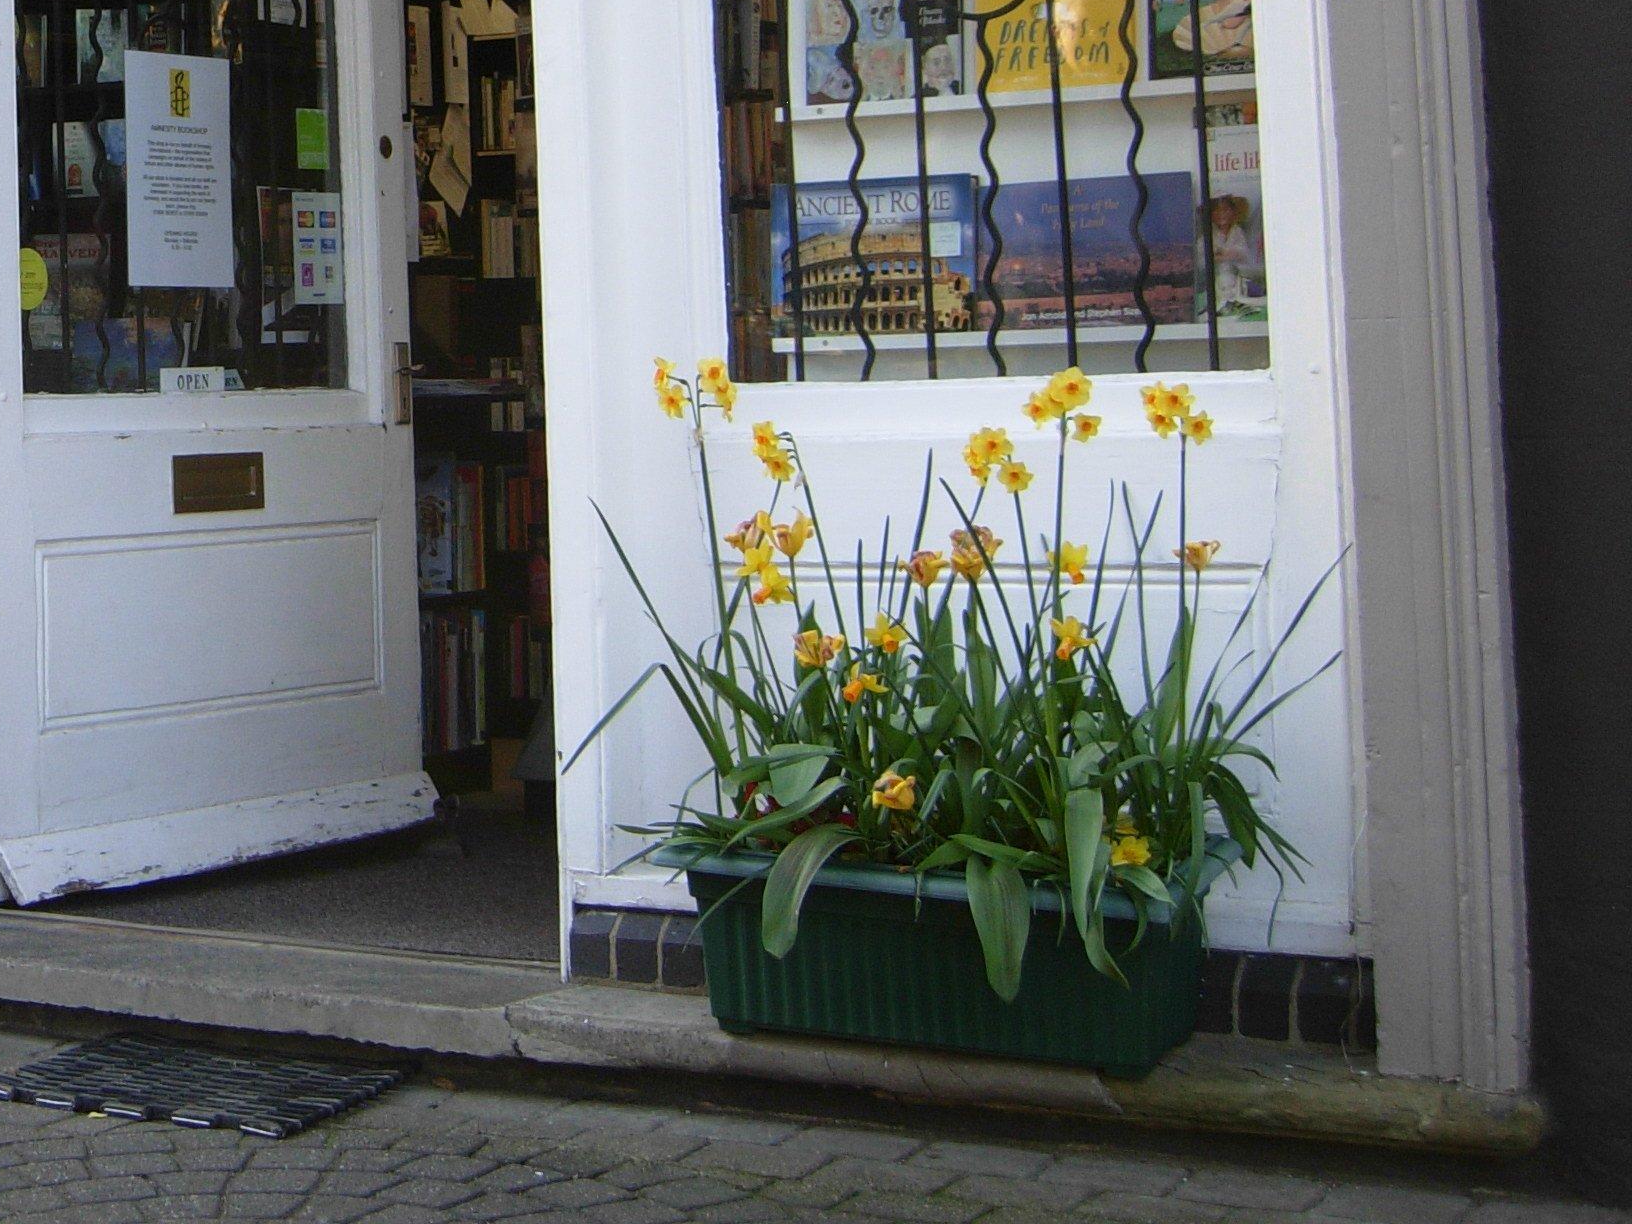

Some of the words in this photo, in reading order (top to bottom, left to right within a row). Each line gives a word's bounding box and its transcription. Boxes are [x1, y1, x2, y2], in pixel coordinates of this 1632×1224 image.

[999, 17, 1089, 45] DRES
[796, 193, 885, 218] ANCIET
[177, 373, 210, 391] OPEN
